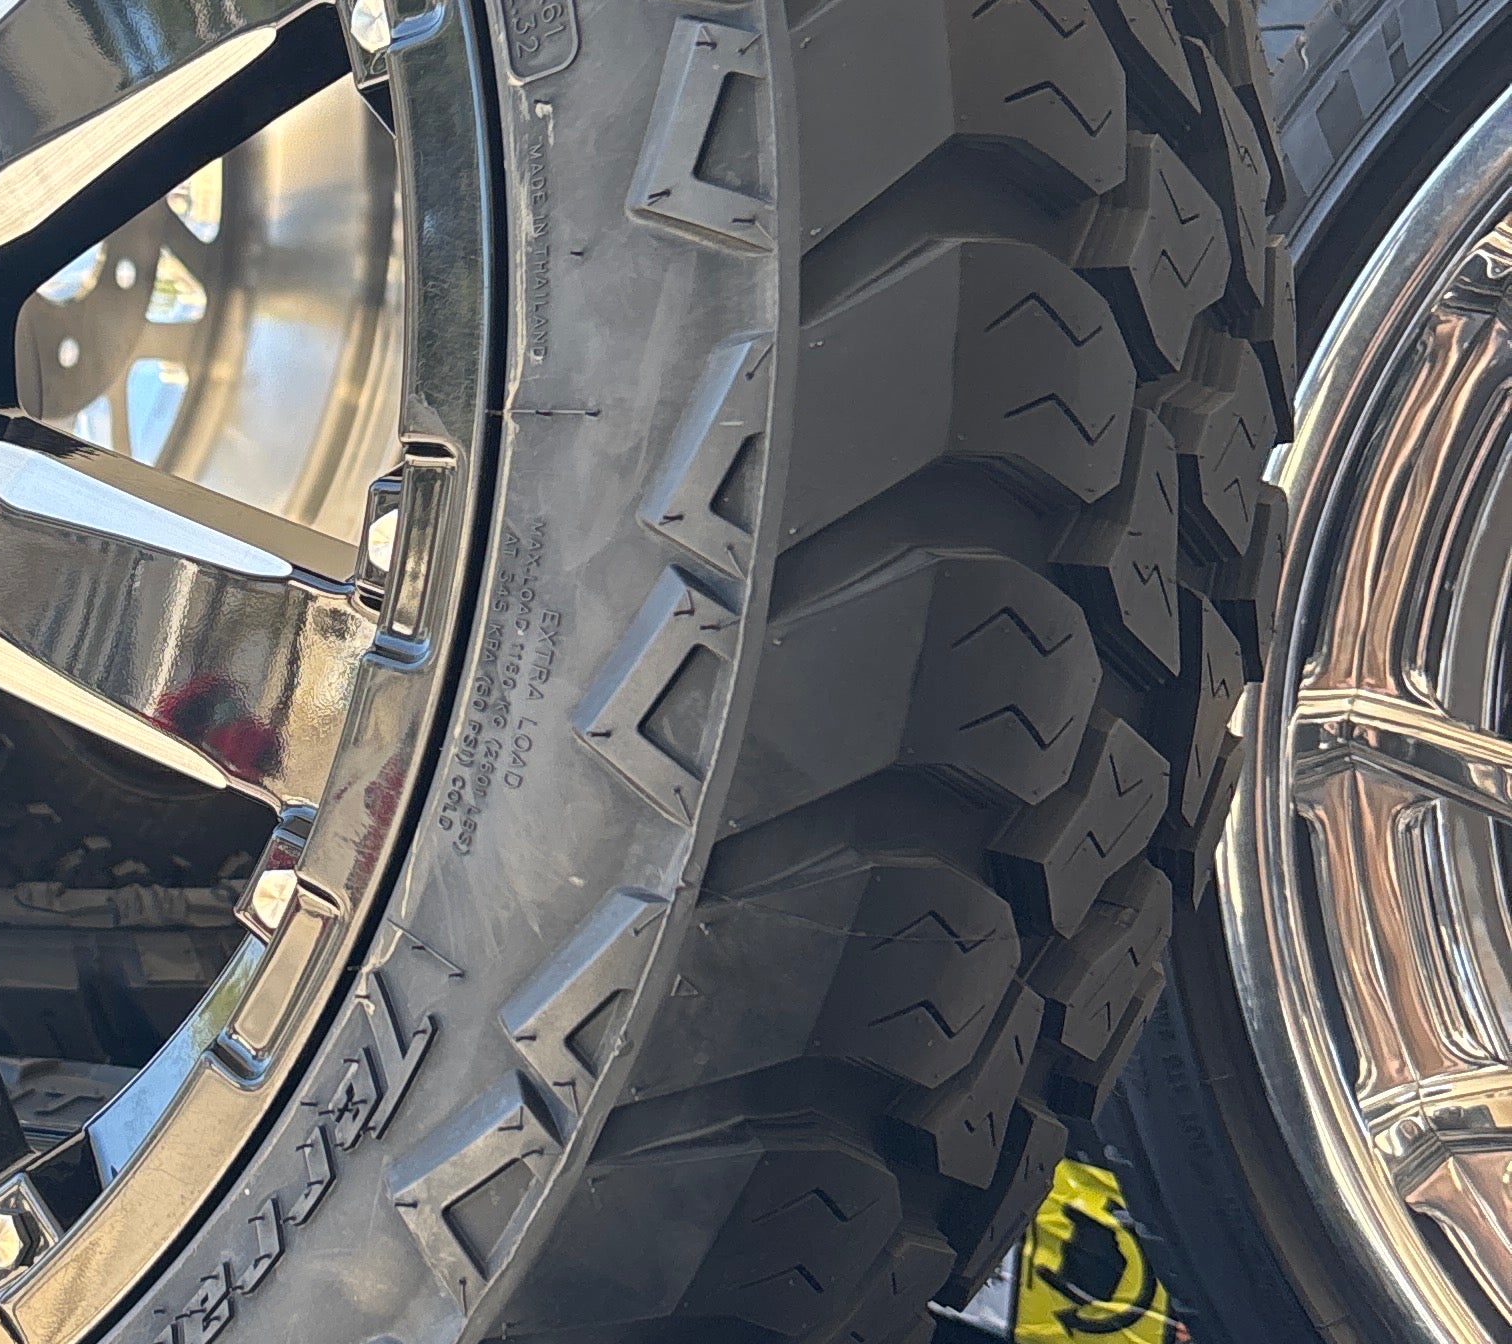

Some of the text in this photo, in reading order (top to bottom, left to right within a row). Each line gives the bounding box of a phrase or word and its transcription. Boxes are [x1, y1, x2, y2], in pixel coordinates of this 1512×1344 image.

[528, 140, 551, 362] MADE IN THAILAND
[502, 532, 521, 558] AT
[471, 673, 495, 714] (50
[492, 699, 513, 732] KG
[503, 607, 561, 790] EXTRA LOAD
[438, 773, 467, 832] COLD
[451, 803, 482, 856] LBS)
